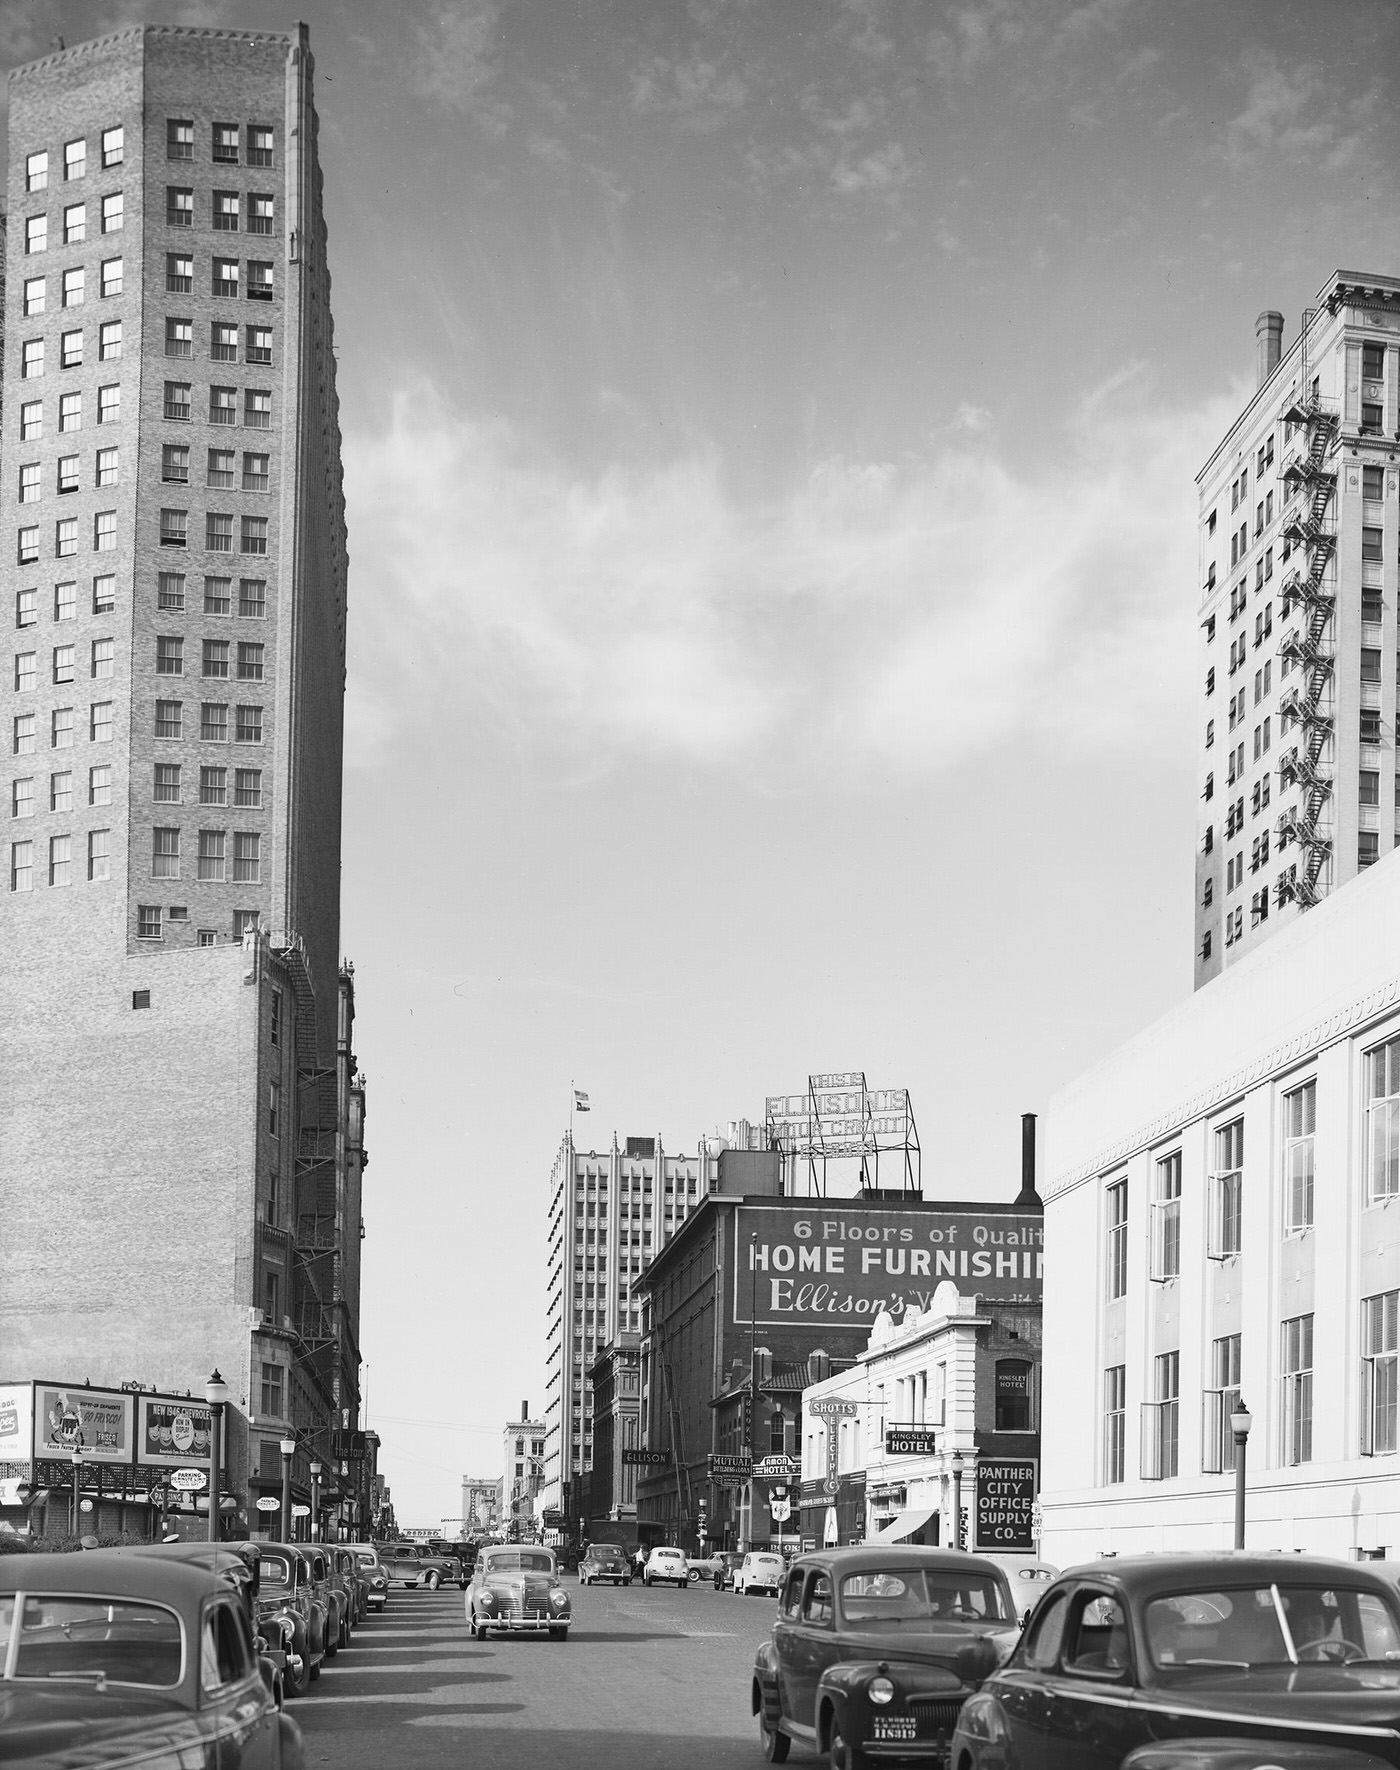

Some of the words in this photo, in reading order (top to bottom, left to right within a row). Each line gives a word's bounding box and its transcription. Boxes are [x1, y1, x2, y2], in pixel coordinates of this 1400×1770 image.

[766, 1090, 907, 1117] ELLISON'S
[793, 1220, 812, 1239] 6
[822, 1221, 914, 1242] Floors
[929, 1225, 958, 1243] of
[972, 1225, 1044, 1247] Qualit
[749, 1244, 845, 1273] HOME
[769, 1278, 904, 1314] Ellison's
[153, 1405, 166, 1415] NEW
[181, 1408, 210, 1420] CHEVROLE
[813, 1403, 853, 1413] SHOTTS
[84, 1411, 93, 1421] GO
[94, 1412, 122, 1425] FRISCO!
[891, 1441, 932, 1452] HOTEL
[626, 1452, 666, 1463] ELLISON
[713, 1457, 750, 1467] MUTUAL
[763, 1466, 790, 1474] HOTEL
[979, 1467, 1033, 1480] PANTHER
[987, 1482, 1022, 1494] CITY
[154, 1492, 182, 1501] PAKING
[979, 1497, 1031, 1509] OFFICE
[979, 1512, 1030, 1524] SUPPLY
